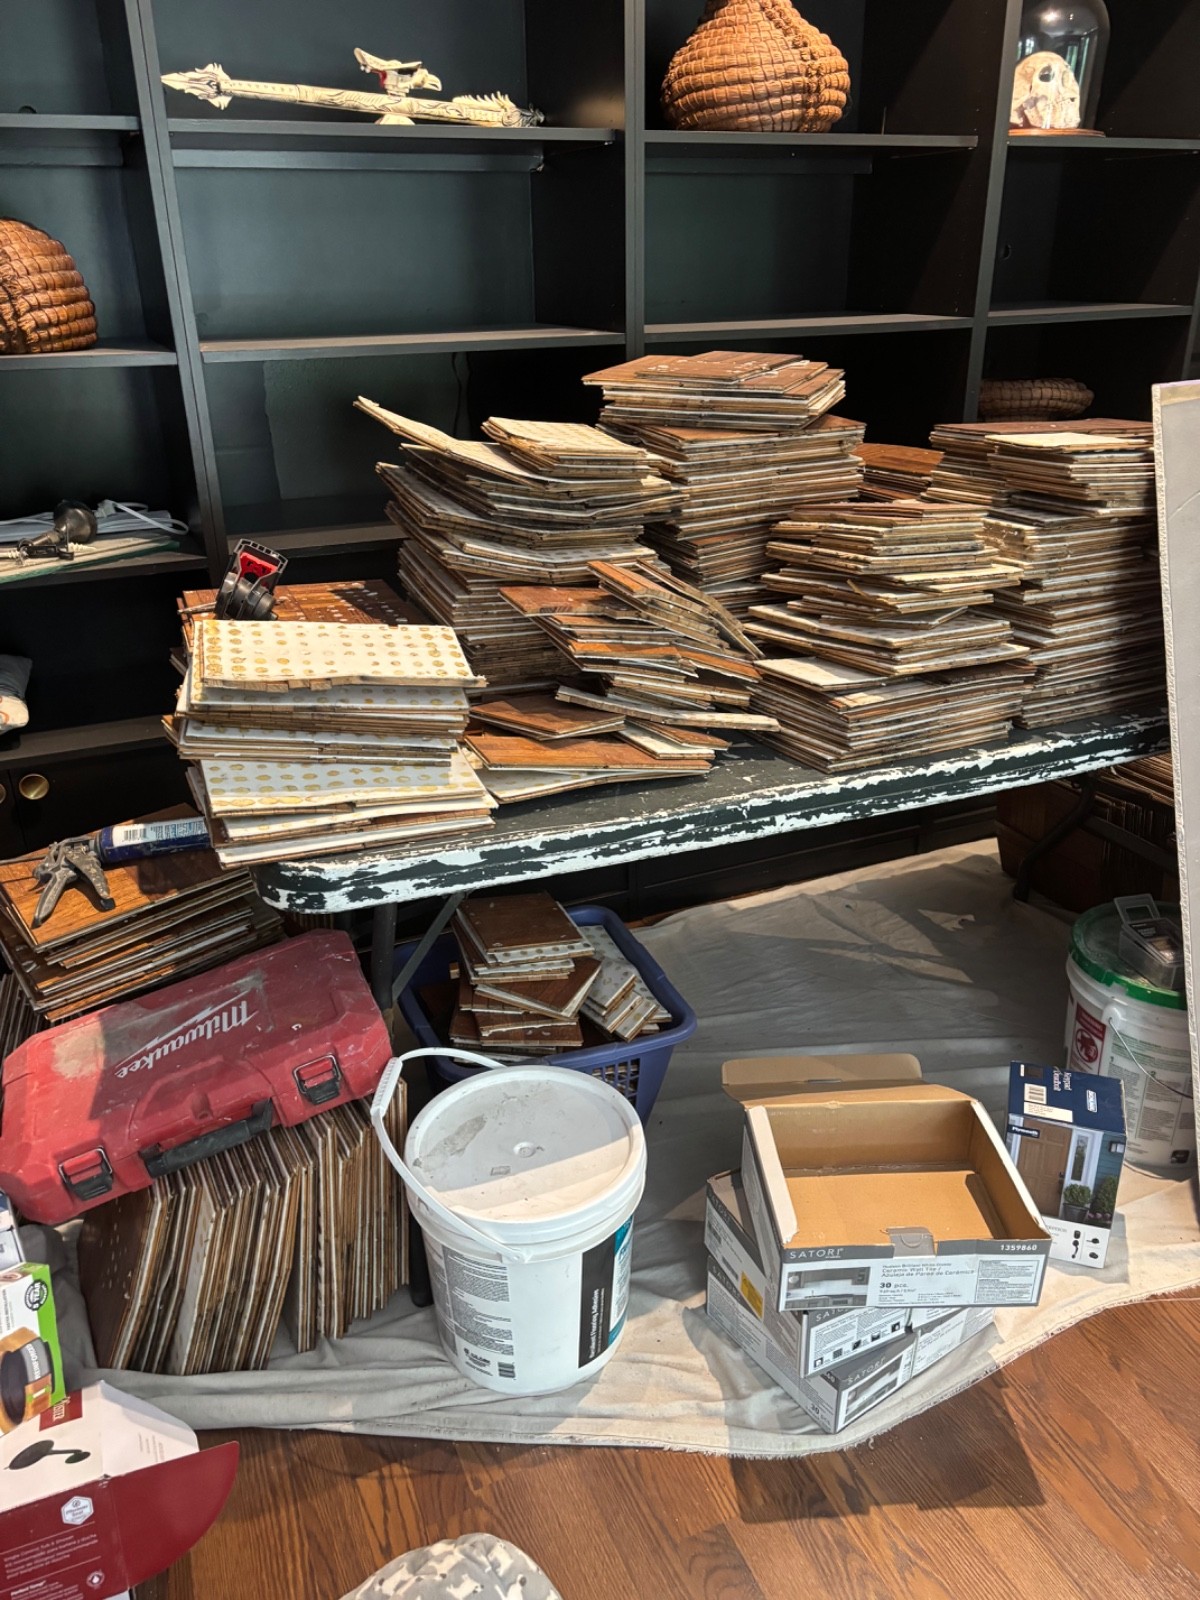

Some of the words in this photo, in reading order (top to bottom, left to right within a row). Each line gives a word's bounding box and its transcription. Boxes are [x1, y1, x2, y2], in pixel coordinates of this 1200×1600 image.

[115, 1000, 258, 1078] Milwaukee
[789, 1248, 844, 1259] SATORI
[847, 1356, 886, 1386] SATORI
